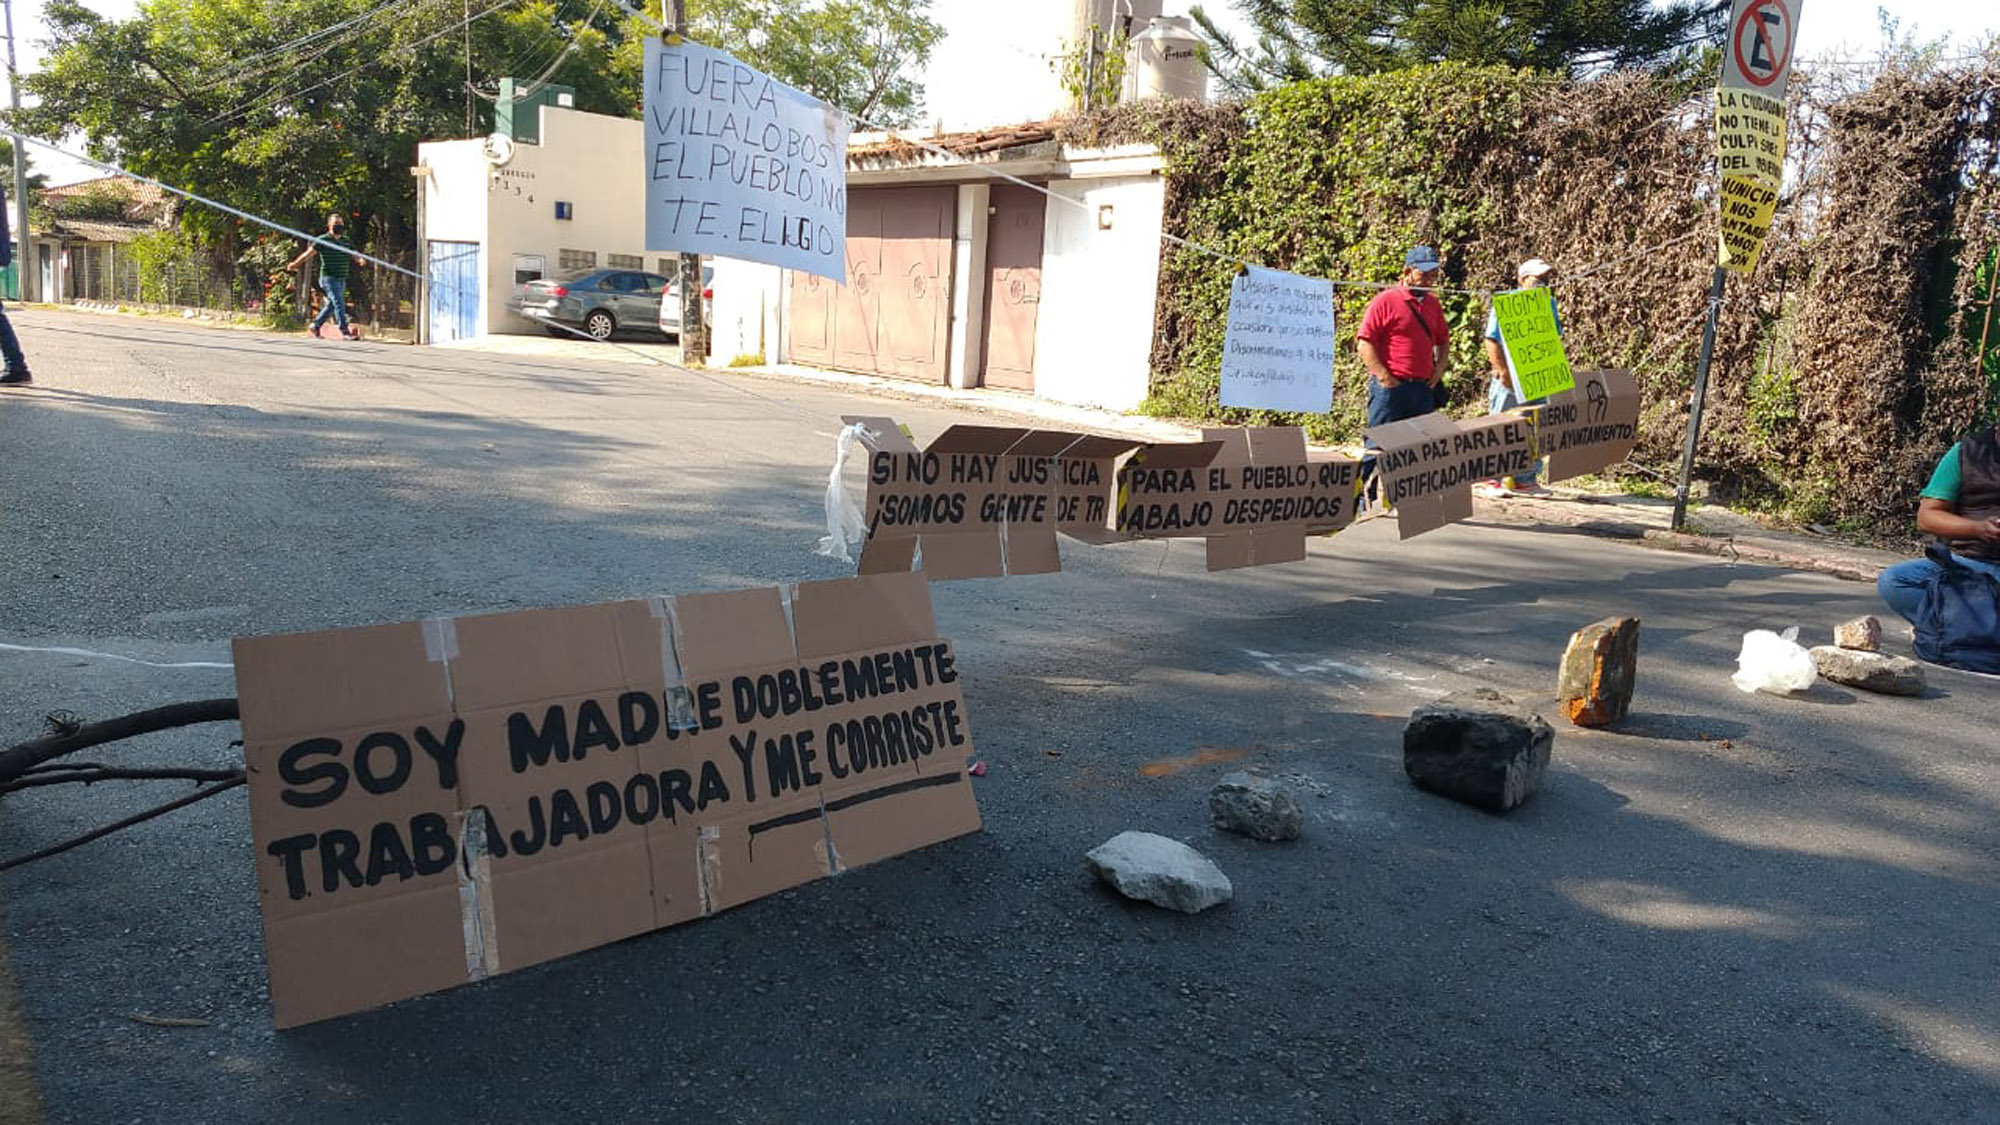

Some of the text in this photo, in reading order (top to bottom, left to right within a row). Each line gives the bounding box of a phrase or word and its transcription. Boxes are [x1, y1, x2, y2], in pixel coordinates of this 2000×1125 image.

[659, 52, 778, 117] FUERA
[1717, 92, 1737, 108] LA
[652, 105, 832, 168] VILLALOBOS
[1719, 115, 1738, 129] NO
[1742, 115, 1770, 134] TIENE
[1722, 156, 1751, 169] DEL
[820, 177, 845, 215] NO
[1729, 201, 1757, 219] NOS
[1422, 438, 1450, 461] PAZ
[1454, 427, 1500, 455] PARA
[1504, 422, 1525, 445] EL
[873, 451, 897, 485] SI
[906, 451, 940, 485] NO
[951, 453, 998, 484] HAY
[1131, 469, 1196, 494] PARA
[1208, 467, 1232, 491] EL
[1319, 462, 1351, 489] QUE
[980, 492, 1048, 524] GENTE
[1057, 496, 1080, 522] DE
[1086, 495, 1105, 523] TR
[1126, 497, 1342, 531] ABAJO DESPEDIDOS
[278, 643, 958, 808] SOY MADRE DOBLEMENTE
[267, 699, 966, 900] TRABAJADORA Y ME CORRISTE
